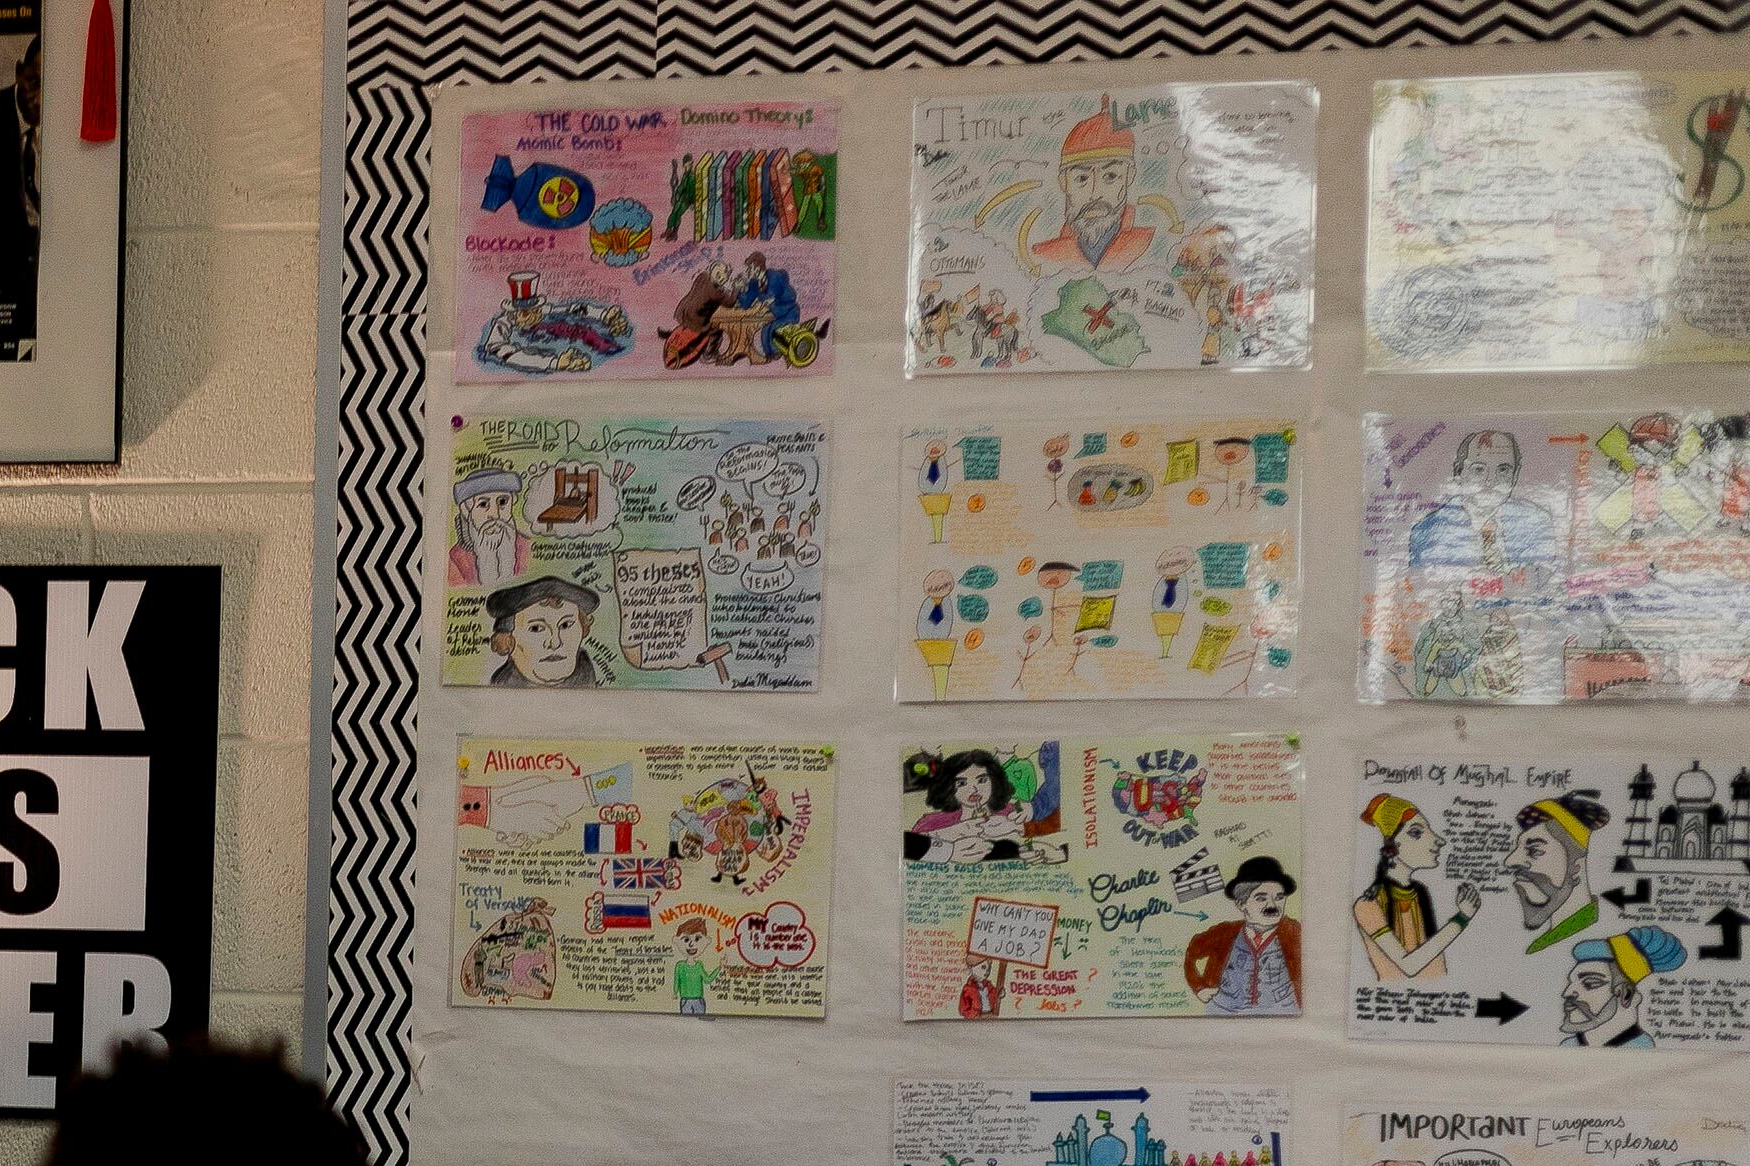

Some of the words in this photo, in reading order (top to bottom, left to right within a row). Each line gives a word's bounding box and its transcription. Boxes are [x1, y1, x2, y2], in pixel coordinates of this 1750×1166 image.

[534, 111, 571, 132] THE
[581, 114, 621, 134] COLD
[680, 107, 741, 125] Domino
[925, 105, 1031, 144] Timur
[479, 421, 507, 437] THE
[557, 418, 728, 460] Reformation
[617, 565, 639, 583] 95
[747, 572, 786, 590] YEAH!
[483, 749, 565, 775] Alliances
[1135, 749, 1199, 774] KEEP
[1082, 746, 1099, 850] ISOLATIONISM
[1122, 819, 1153, 848] OUT
[458, 882, 503, 899] Treaty
[1087, 867, 1161, 904] Charlie
[979, 903, 1000, 914] WHY
[1033, 907, 1054, 923] YOU
[1097, 896, 1173, 934] Chaplin
[973, 918, 995, 934] GIVE
[998, 924, 1016, 938] MY
[1019, 926, 1047, 940] DAD
[1057, 917, 1094, 934] MONEY
[976, 937, 989, 951] A
[994, 937, 1027, 958] JOB
[1012, 968, 1037, 980] THE
[1042, 968, 1079, 980] GREAT
[1009, 981, 1078, 997] DEPRESSION
[1535, 1115, 1626, 1148] Europeans
[1585, 1131, 1679, 1159] Explorers
